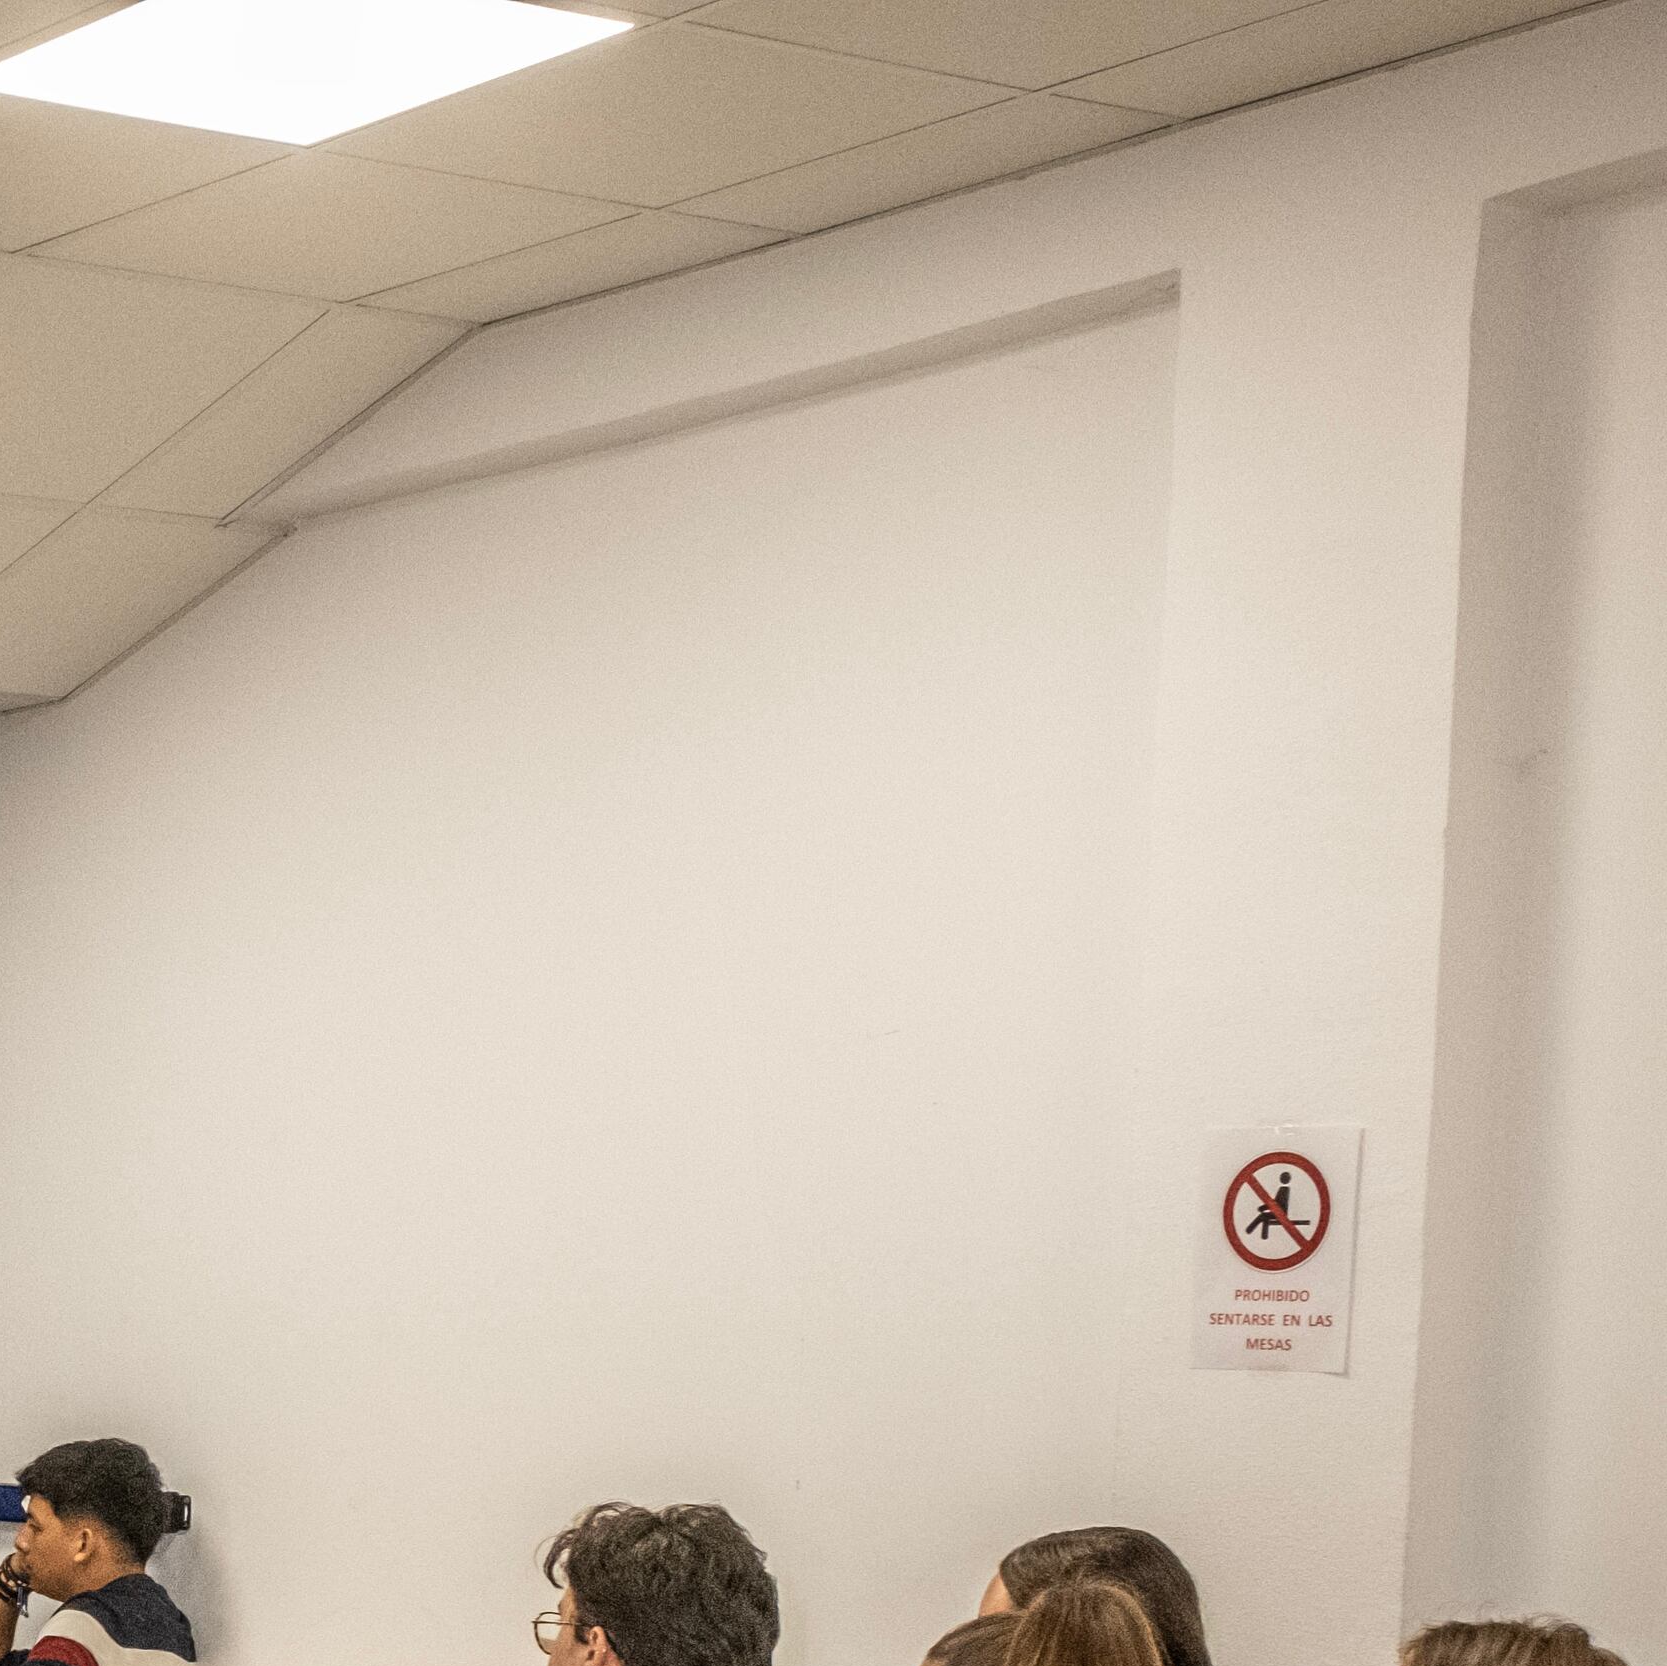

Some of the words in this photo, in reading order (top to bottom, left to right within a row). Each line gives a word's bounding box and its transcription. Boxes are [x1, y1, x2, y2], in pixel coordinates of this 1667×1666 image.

[1234, 1288, 1310, 1303] PROHIBIDO
[1209, 1311, 1275, 1327] SENTARSE
[1282, 1313, 1301, 1327] EN
[1308, 1313, 1333, 1328] LAS
[1245, 1337, 1292, 1352] MESAS
